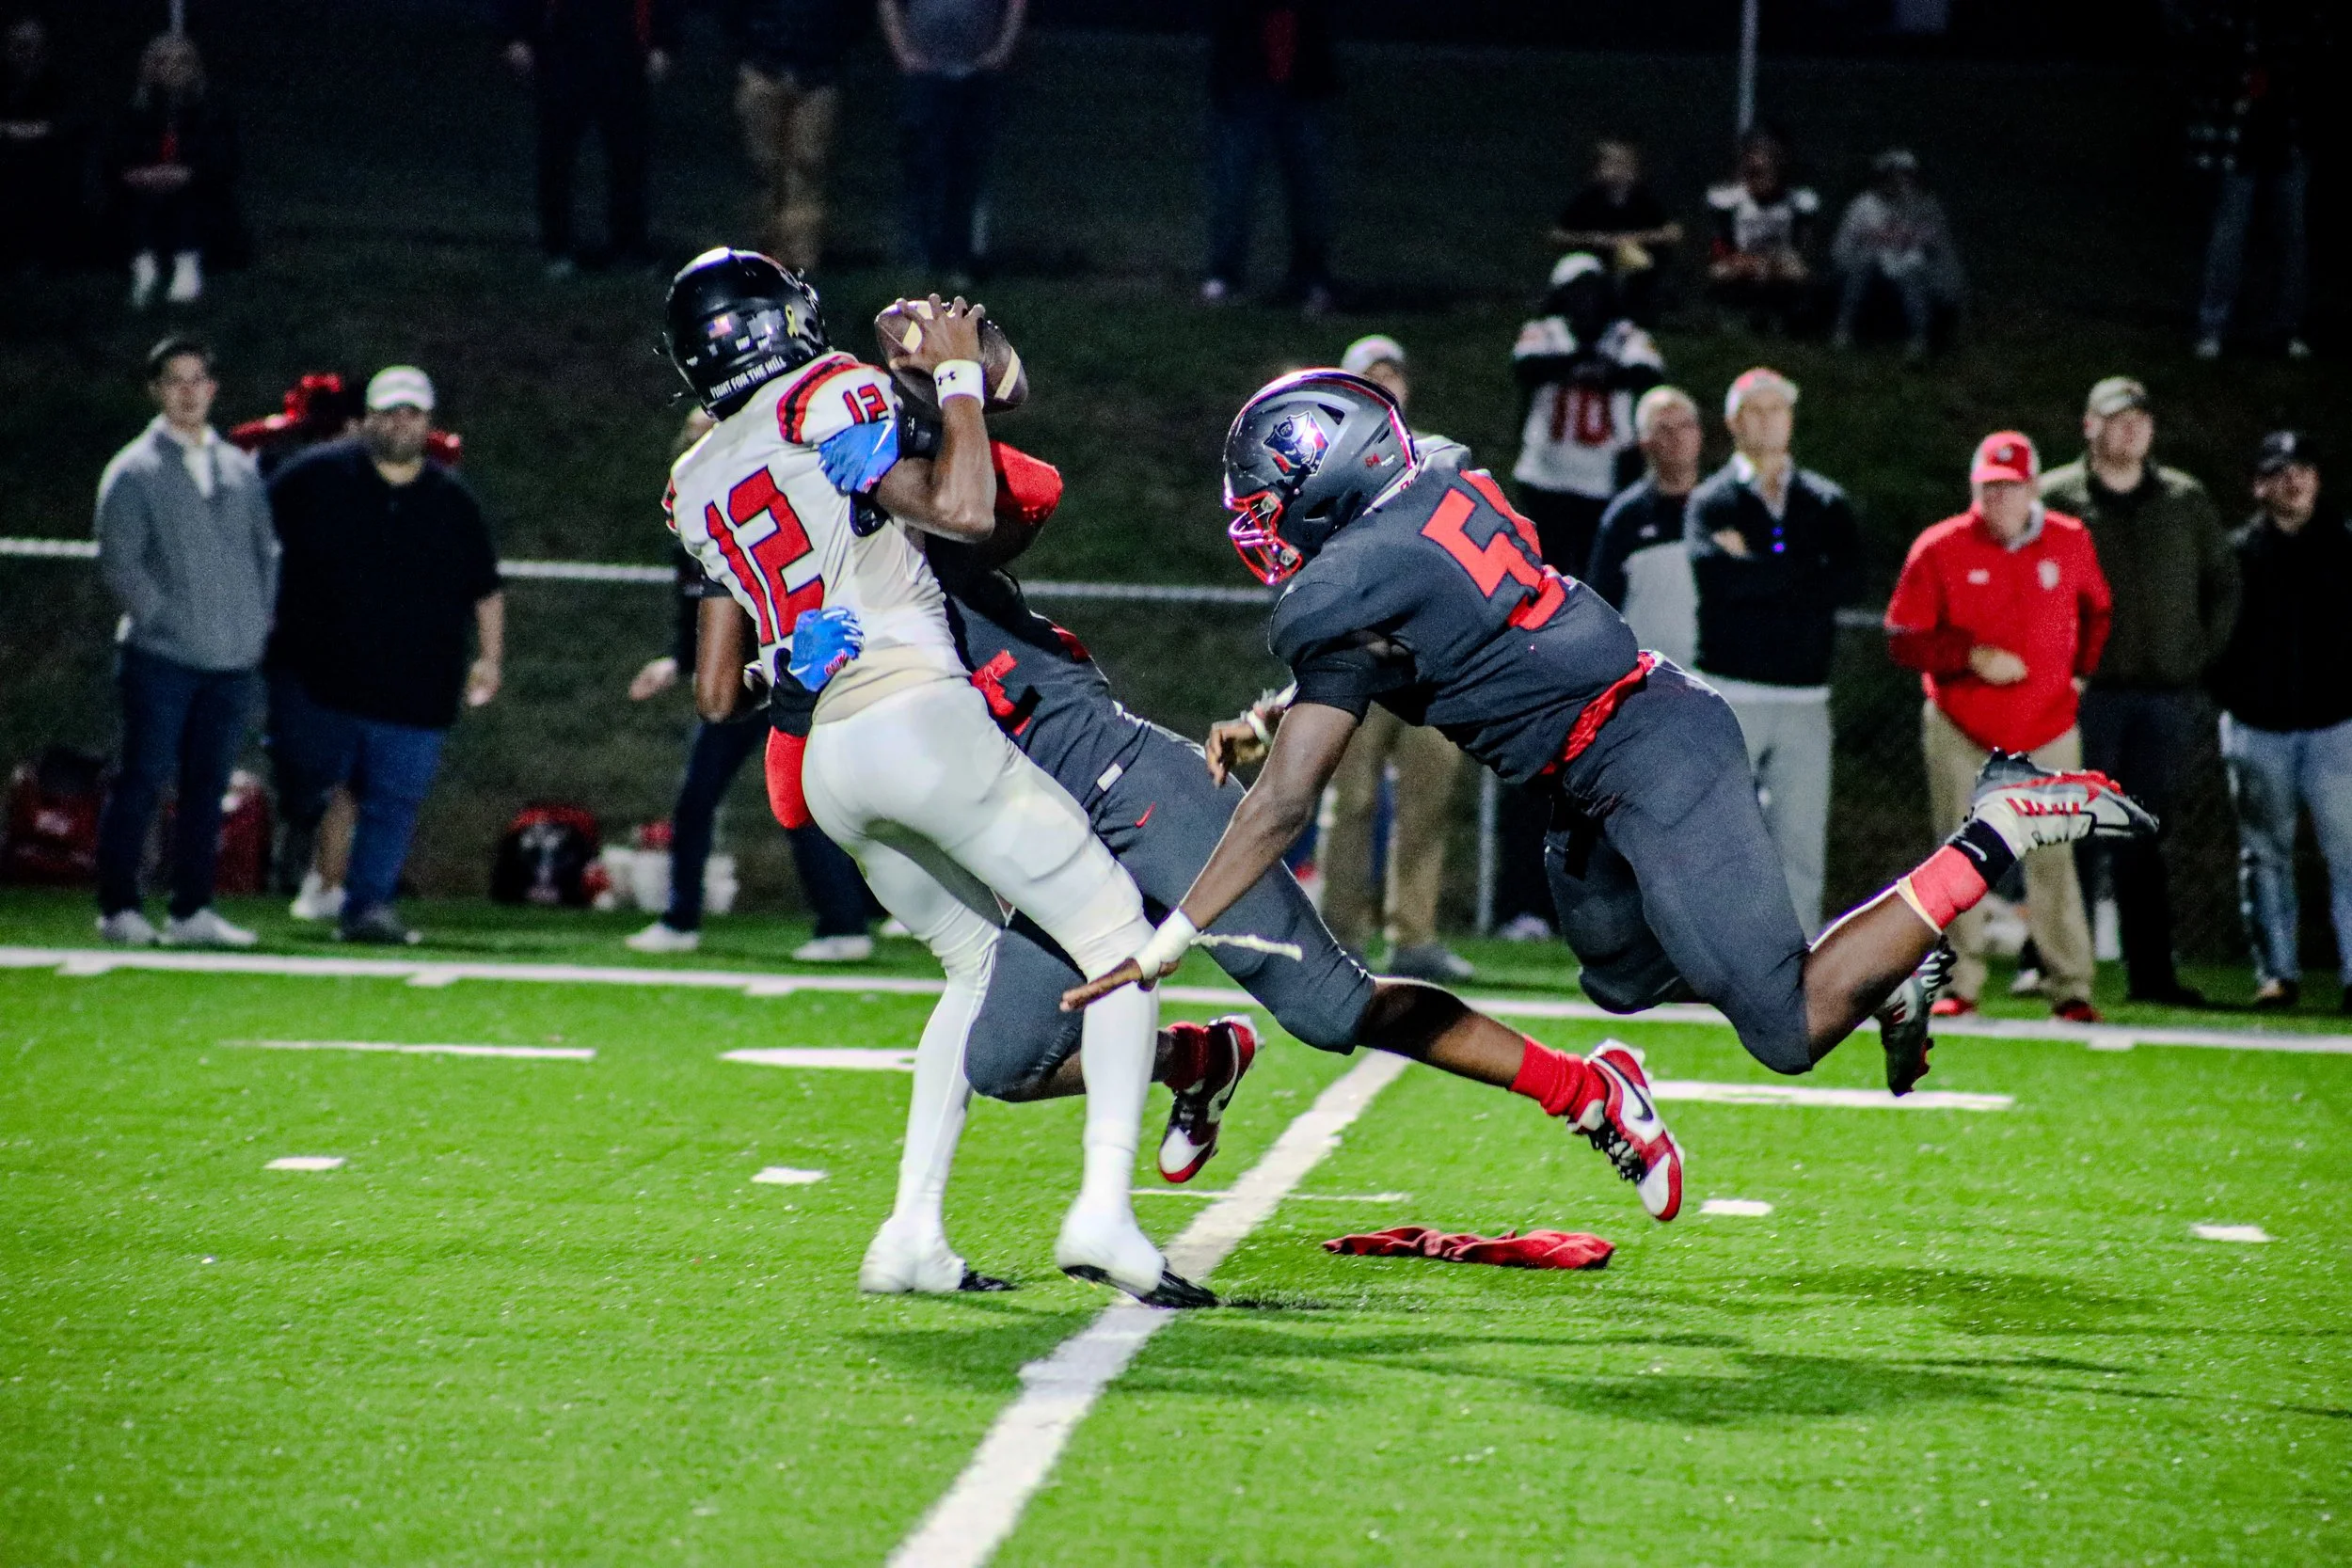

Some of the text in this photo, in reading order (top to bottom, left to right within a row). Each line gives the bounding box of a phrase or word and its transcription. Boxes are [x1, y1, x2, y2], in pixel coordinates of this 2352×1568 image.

[709, 380, 732, 400] FIGHT
[731, 372, 750, 390] FOR
[747, 364, 767, 382] THE
[842, 383, 889, 425] 12
[705, 465, 825, 646] 12
